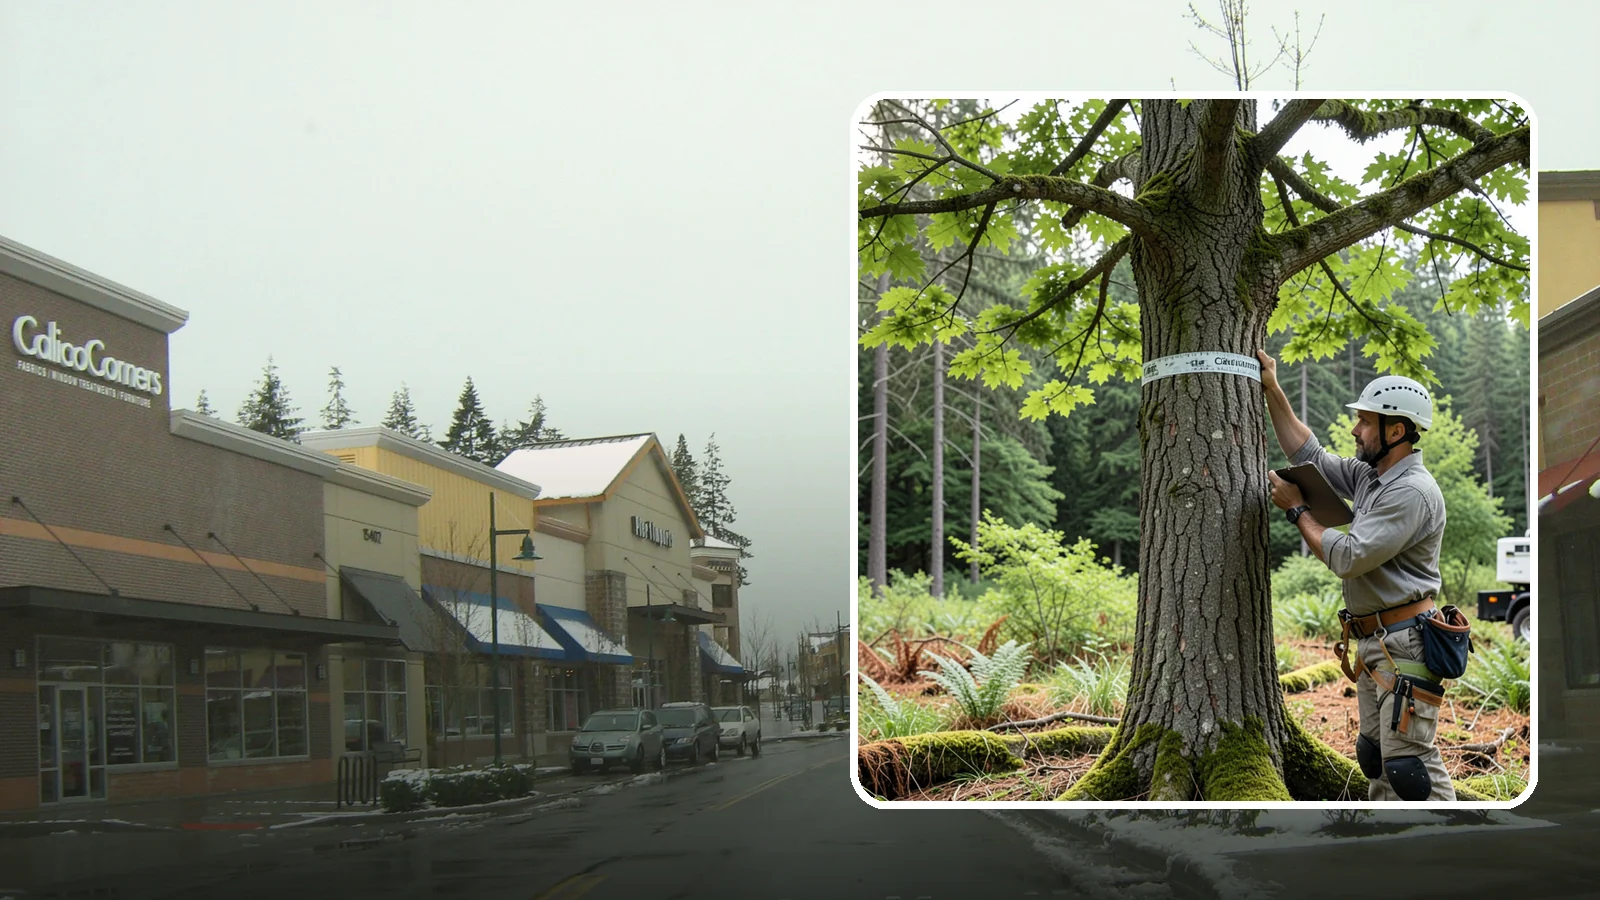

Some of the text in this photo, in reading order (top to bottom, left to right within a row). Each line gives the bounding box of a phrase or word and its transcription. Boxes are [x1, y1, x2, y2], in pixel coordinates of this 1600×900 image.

[17, 360, 151, 408] FABRICS WINDOW TREATMENTS FURNITURE
